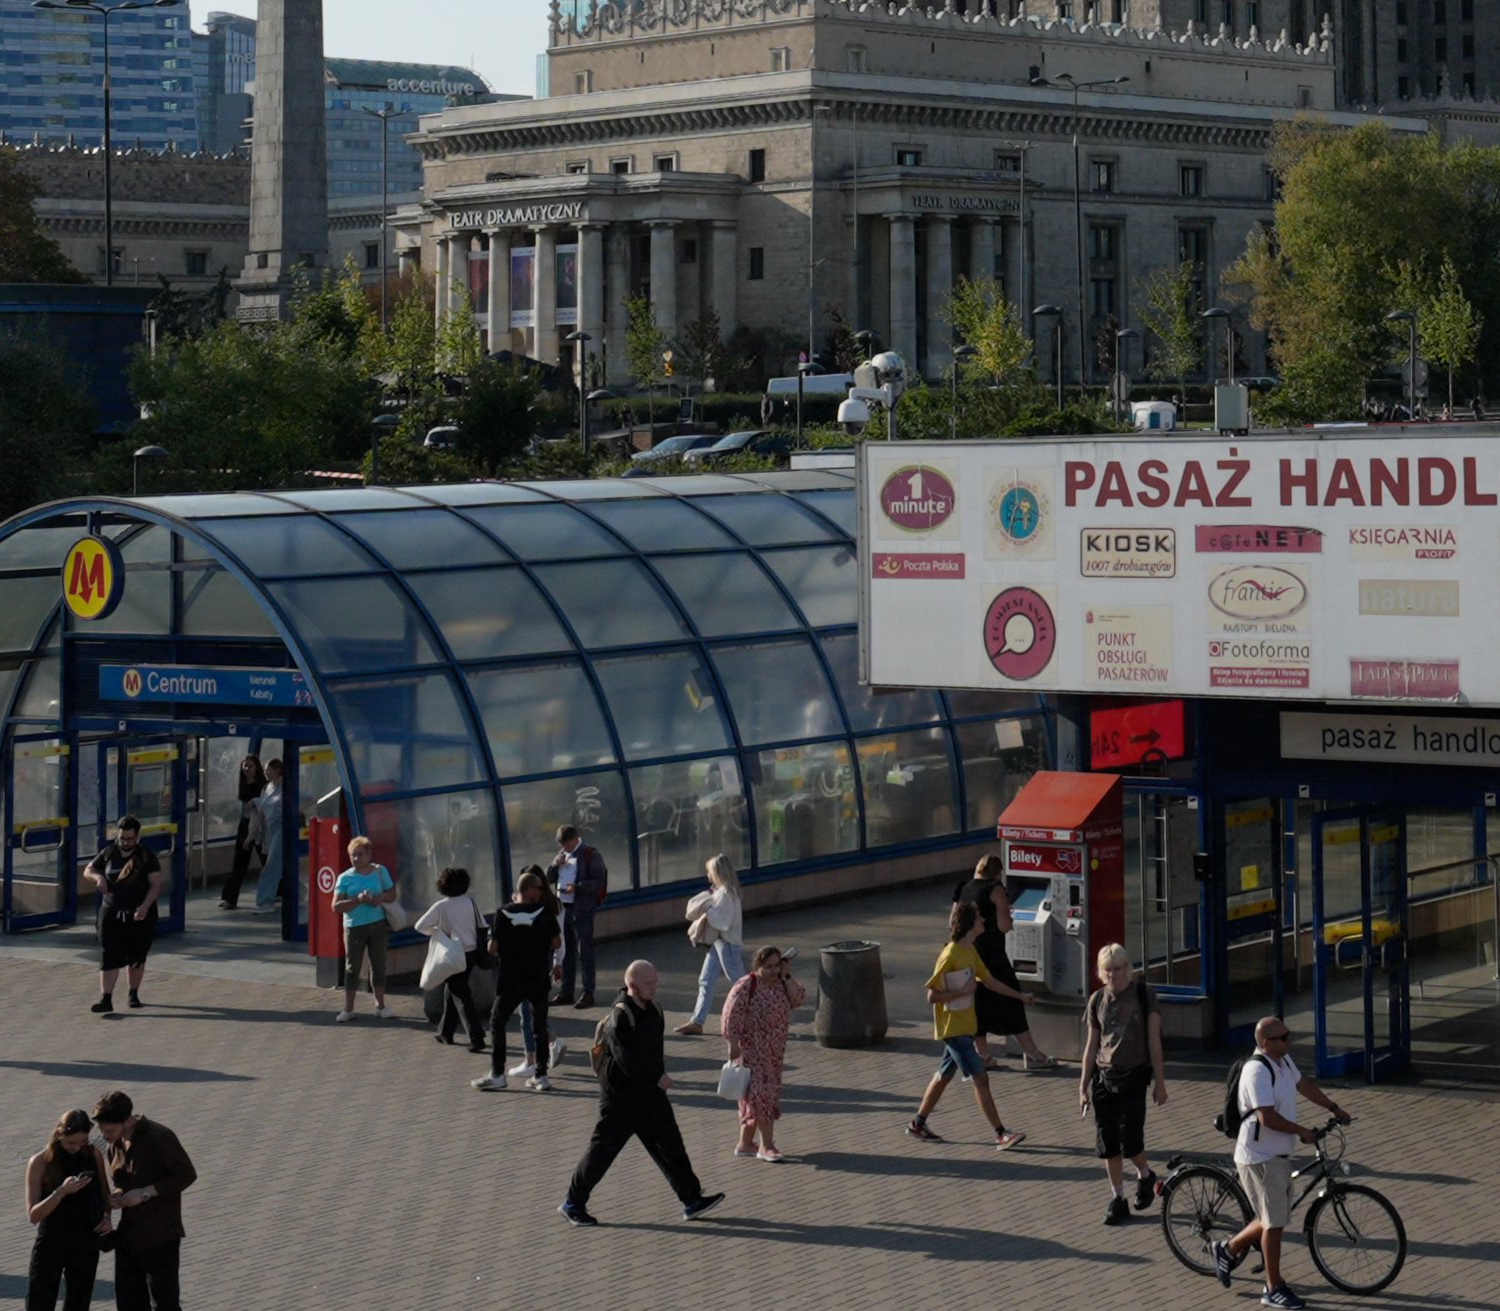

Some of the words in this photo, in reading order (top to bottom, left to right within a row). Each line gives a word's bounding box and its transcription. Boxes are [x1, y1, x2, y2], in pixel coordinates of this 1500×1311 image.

[387, 78, 474, 96] accenture
[447, 210, 484, 228] TEATR
[487, 202, 582, 225] DRAMATYCZNY
[907, 473, 922, 499] 1
[1064, 447, 1252, 508] PASAŻ
[890, 496, 946, 514] minute
[1086, 535, 1172, 553] KIOSK
[1349, 528, 1457, 547] KSIĘGARNIA
[903, 560, 931, 572] Poczta
[933, 560, 959, 572] Polska
[68, 551, 105, 604] M
[1097, 633, 1136, 646] PUNKT
[1097, 650, 1147, 664] OBSŁUGI
[1221, 641, 1310, 659] Fotoforma
[250, 673, 276, 686] kierunek
[1097, 665, 1168, 682] PASAŻERÓW
[147, 672, 217, 696] Centrum
[250, 689, 273, 702] Kabaty
[1321, 722, 1397, 754] pasaż
[1010, 849, 1042, 867] Bilety
